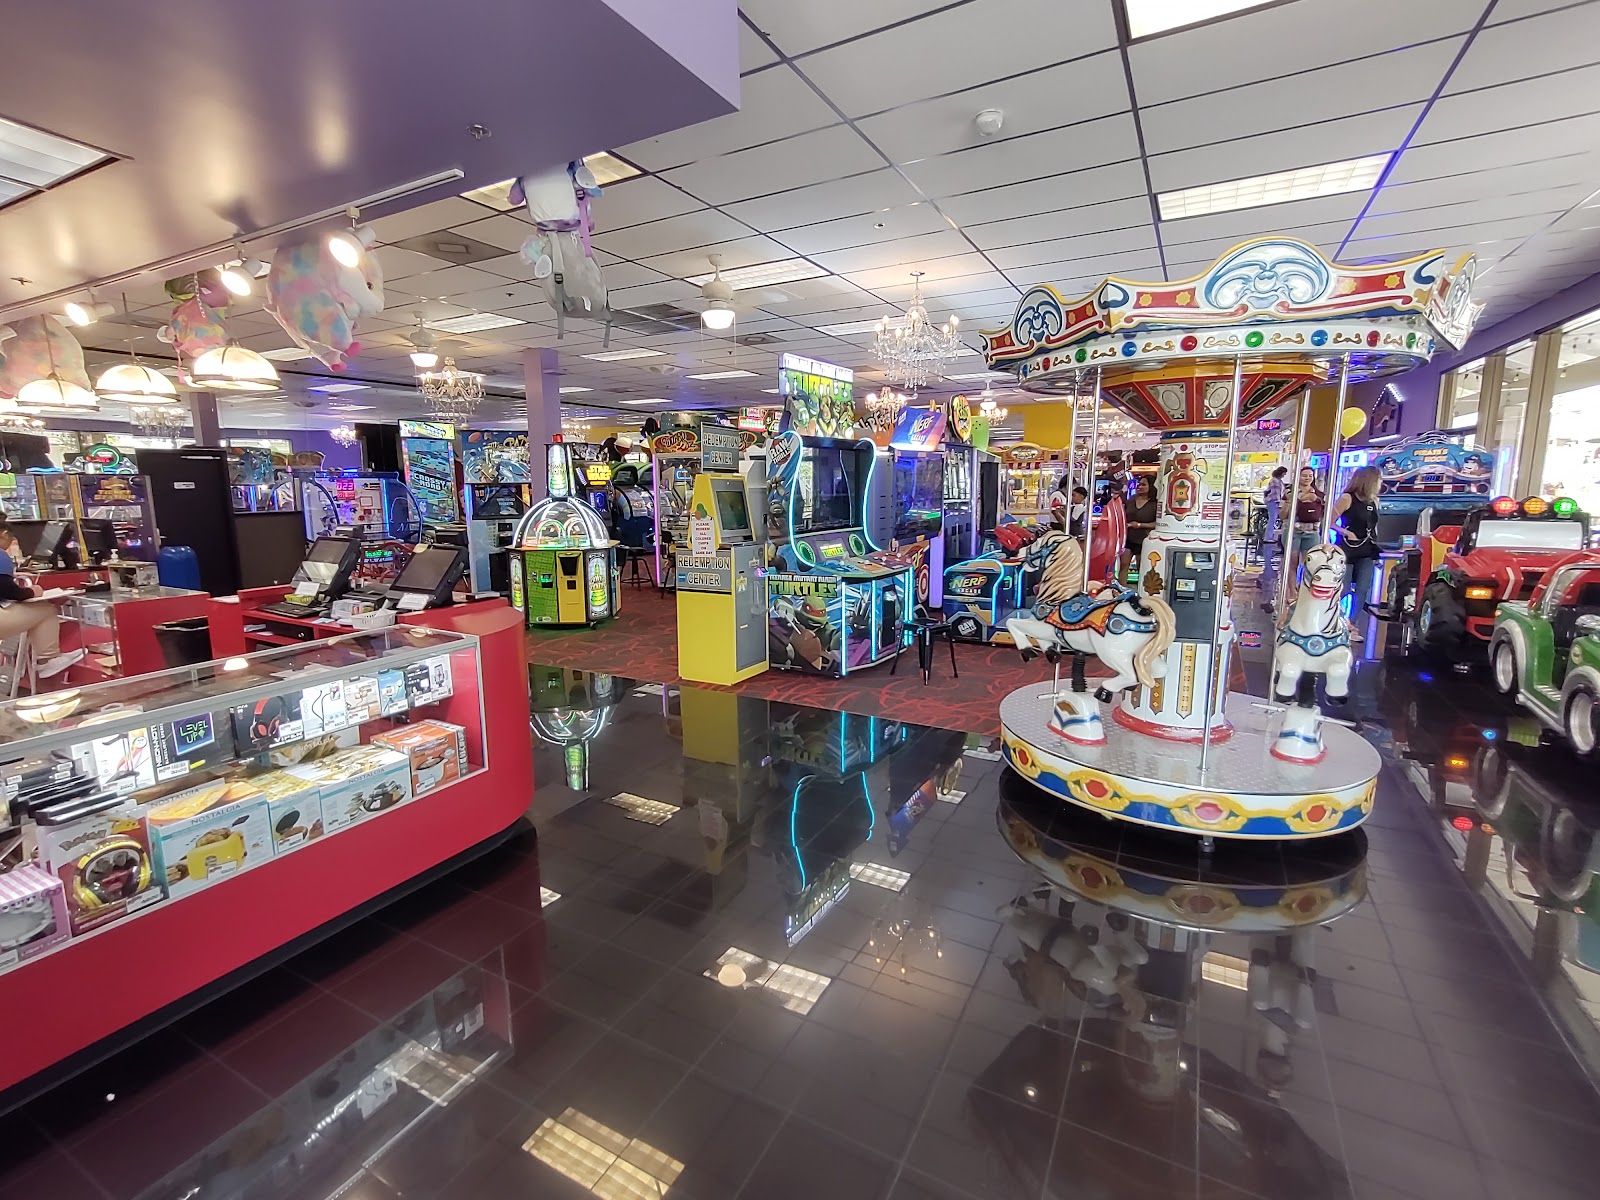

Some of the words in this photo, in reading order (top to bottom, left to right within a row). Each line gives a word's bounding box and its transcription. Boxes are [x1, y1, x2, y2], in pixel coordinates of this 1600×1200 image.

[703, 432, 739, 449] REDEMPTION
[710, 451, 732, 464] CENTER
[687, 572, 721, 586] CENTER
[952, 575, 987, 588] NERF
[769, 581, 837, 597] TURTLES
[180, 720, 208, 736] LEVEL
[186, 731, 199, 743] UP
[349, 767, 385, 784] NOSTALGIA
[150, 788, 199, 807] NOSTALGIA
[192, 804, 241, 825] NOSTALGIA
